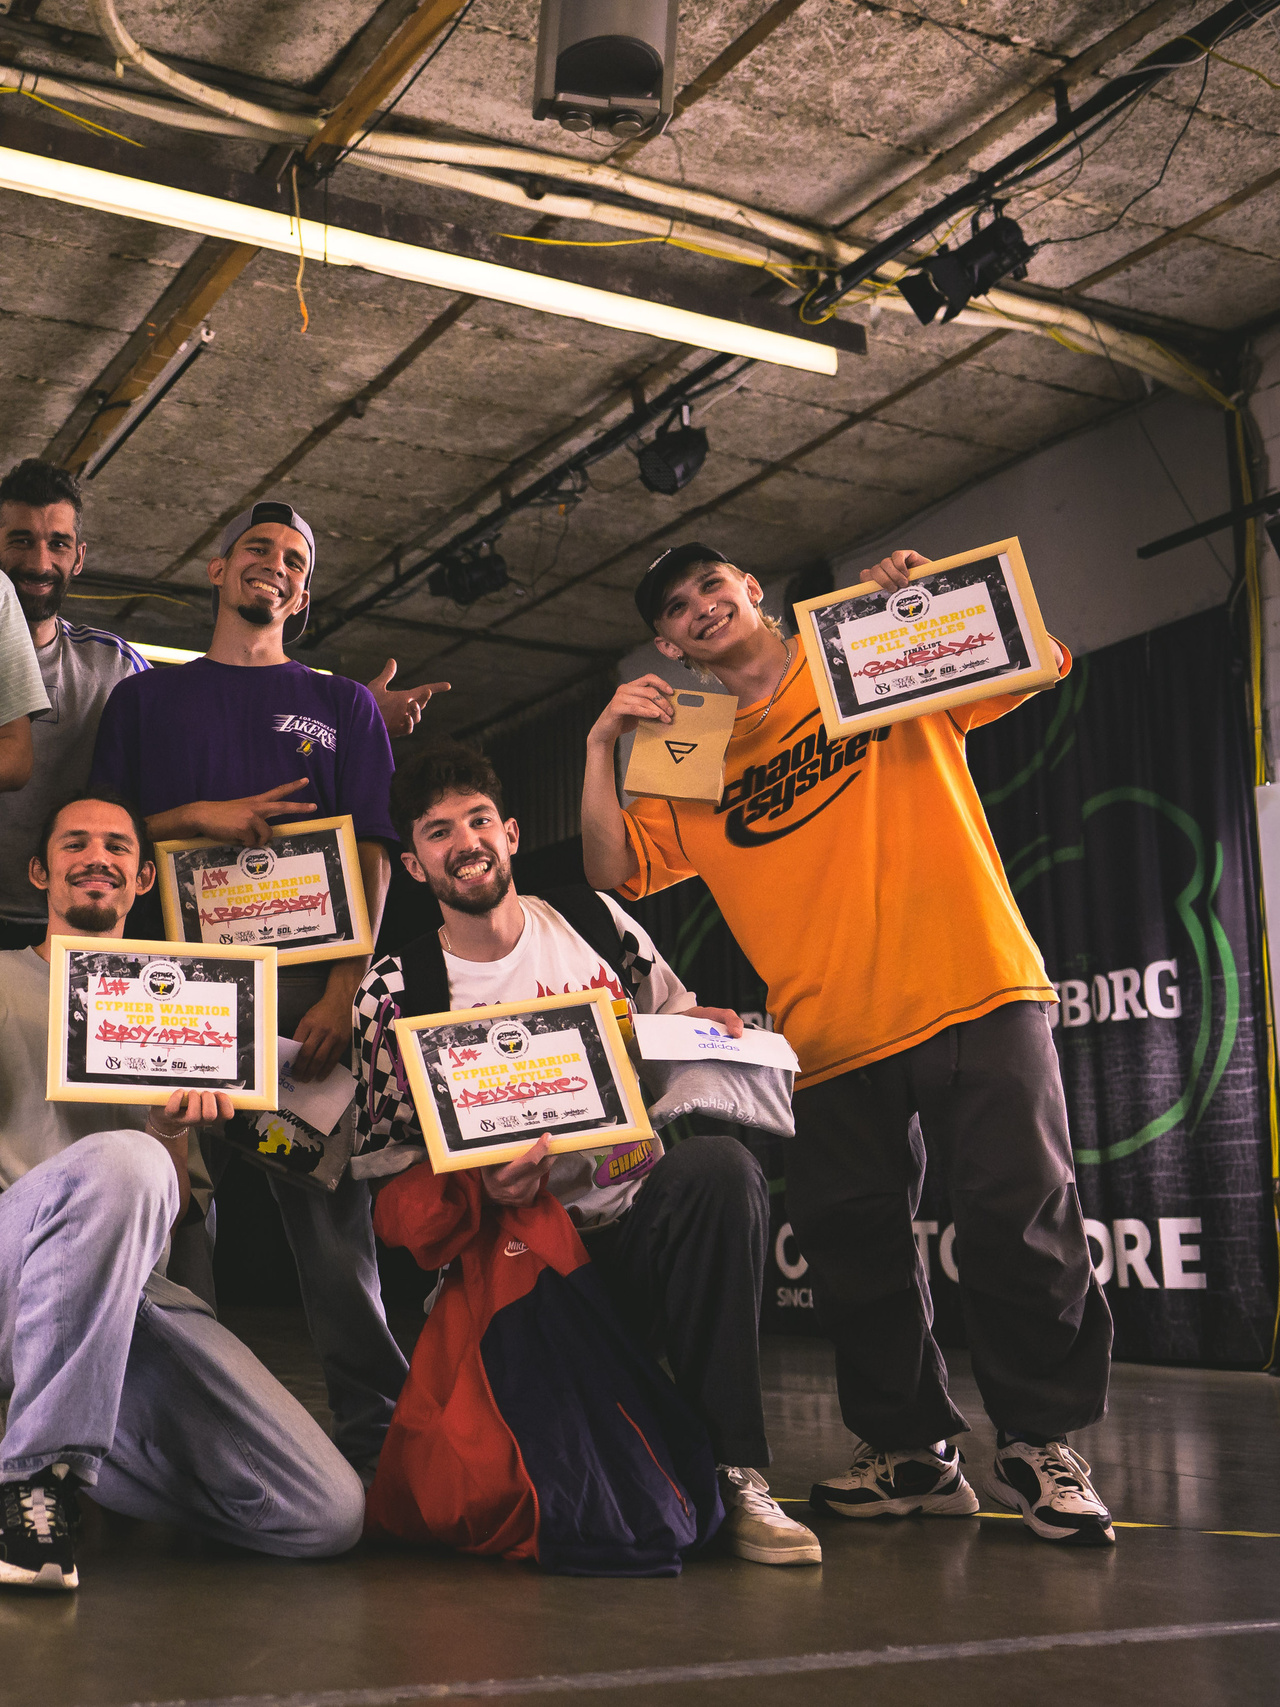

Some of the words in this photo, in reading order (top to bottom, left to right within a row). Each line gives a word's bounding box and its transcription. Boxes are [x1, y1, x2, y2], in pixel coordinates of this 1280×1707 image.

[850, 626, 909, 651] CYPHER
[913, 604, 987, 632] WARRIOR
[876, 642, 905, 655] ALL
[909, 622, 966, 645] STYLES
[903, 641, 941, 656] FINALIST
[276, 715, 336, 750] LAKERS
[202, 884, 253, 899] CYPHER
[258, 874, 321, 891] WARRIOR
[227, 888, 299, 906] FOOTWORK
[95, 1001, 154, 1014] CYPHER
[159, 1003, 230, 1017] WARRIOR
[126, 1014, 155, 1026] TOP
[161, 1016, 199, 1027] ROCK
[698, 1042, 740, 1051] adidas
[452, 1064, 509, 1081] CYPHER
[512, 1052, 582, 1071] WARRIOR
[478, 1078, 506, 1089] ALL
[509, 1067, 563, 1084] STYLES
[1084, 1217, 1207, 1289] ORE
